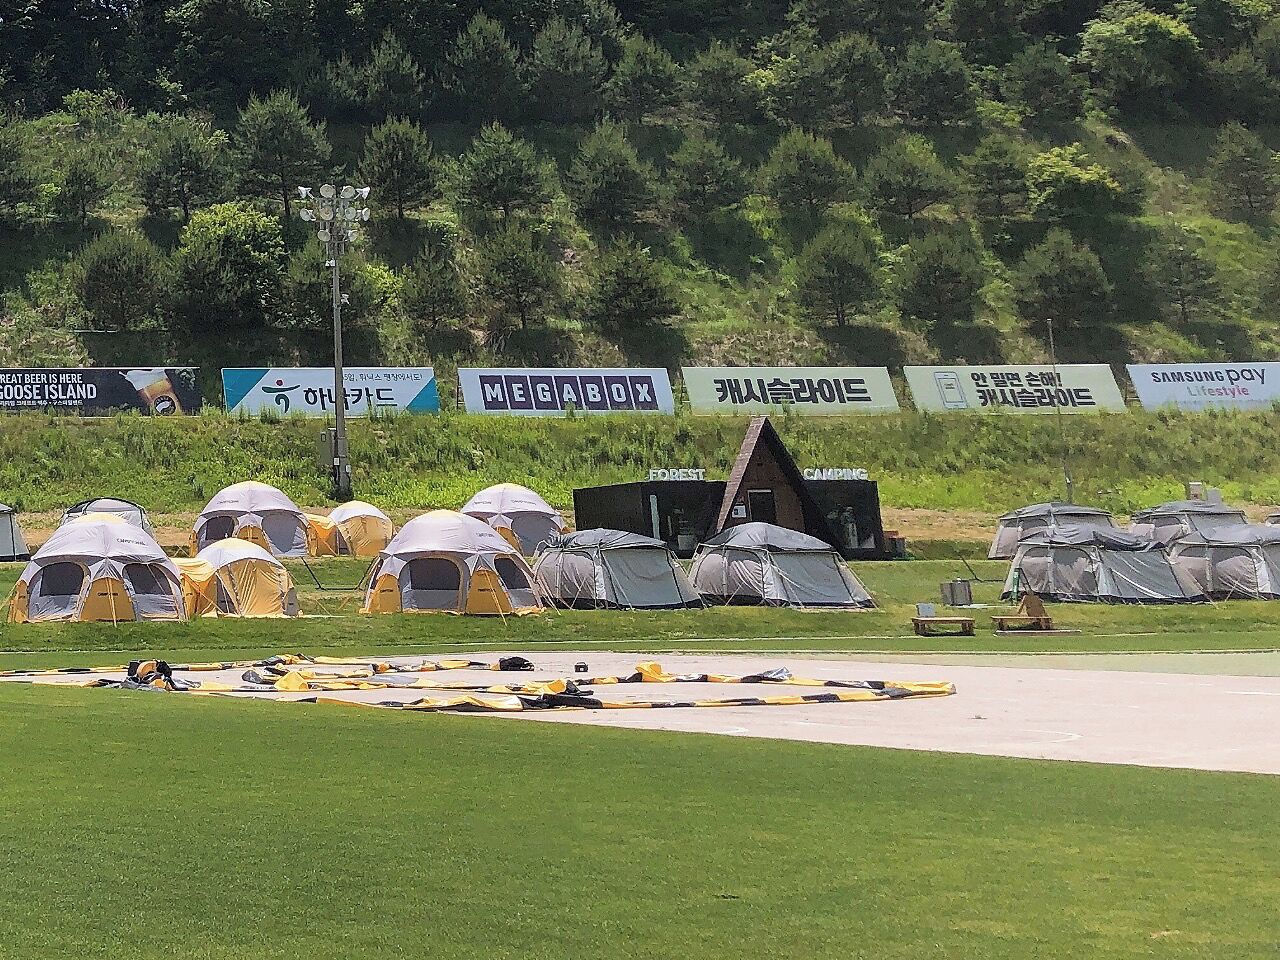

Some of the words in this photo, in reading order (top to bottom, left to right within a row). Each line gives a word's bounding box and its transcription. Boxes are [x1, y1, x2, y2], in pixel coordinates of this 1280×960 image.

[24, 373, 47, 384] BEER
[49, 373, 58, 384] IS
[59, 373, 83, 384] HERE
[970, 372, 989, 388] 안
[990, 371, 1024, 387] 밀면
[1025, 371, 1063, 387] 손해!
[1151, 370, 1225, 383] SAMSUNG
[1225, 368, 1266, 386] pay
[44, 383, 97, 399] ISLAND
[484, 383, 652, 402] MEGABOX
[713, 377, 872, 404] 캐시슬라이드
[977, 388, 1096, 407] 캐시슬라이드
[1187, 385, 1250, 398] Lifestyle
[648, 468, 706, 481] FOREST
[803, 467, 869, 481] CAMPING
